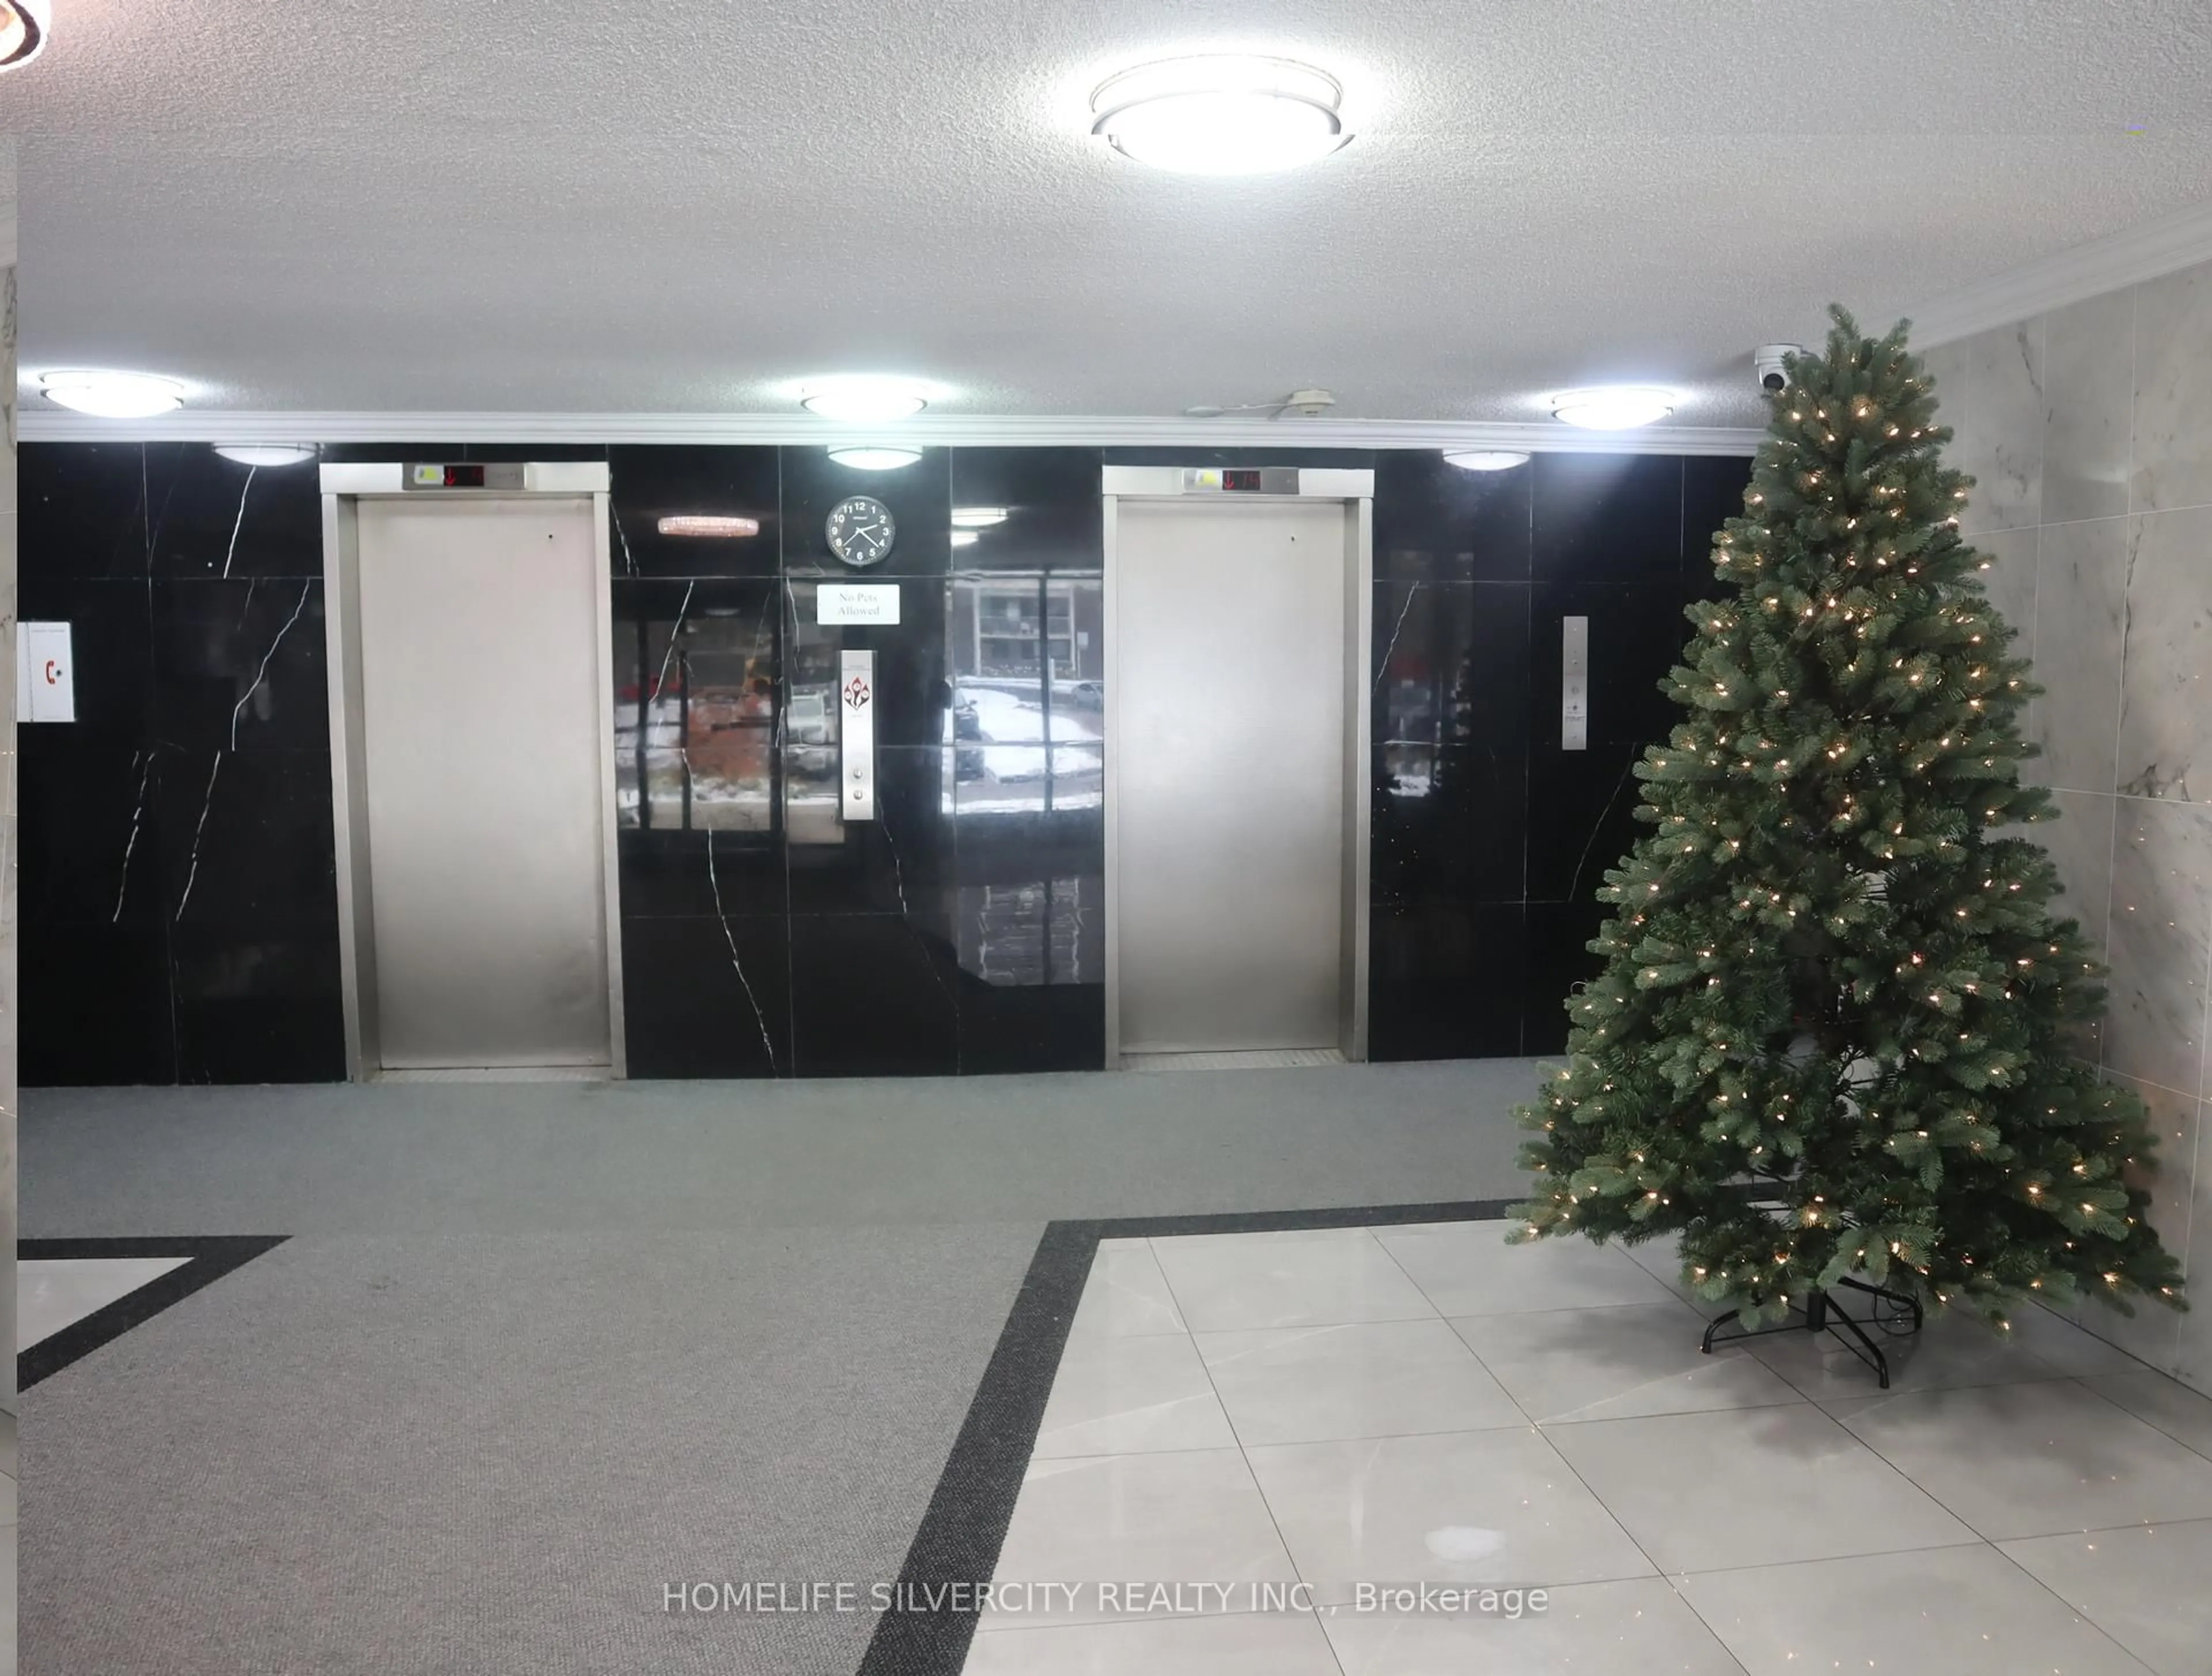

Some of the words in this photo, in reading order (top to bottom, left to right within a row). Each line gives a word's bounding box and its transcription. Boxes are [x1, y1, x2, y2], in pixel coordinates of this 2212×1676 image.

[843, 505, 853, 514] 11
[854, 502, 866, 511] 12
[871, 505, 876, 514] 1
[833, 514, 845, 523] 10
[880, 515, 887, 524] 2
[831, 526, 838, 536] 9
[882, 527, 889, 536] 3
[835, 537, 842, 547] 8
[878, 539, 885, 547] 4
[844, 547, 852, 556] 7
[857, 551, 863, 560] 6
[869, 547, 876, 557] 5
[839, 592, 854, 601] No
[857, 593, 877, 602] Pets
[838, 606, 880, 616] Allowed
